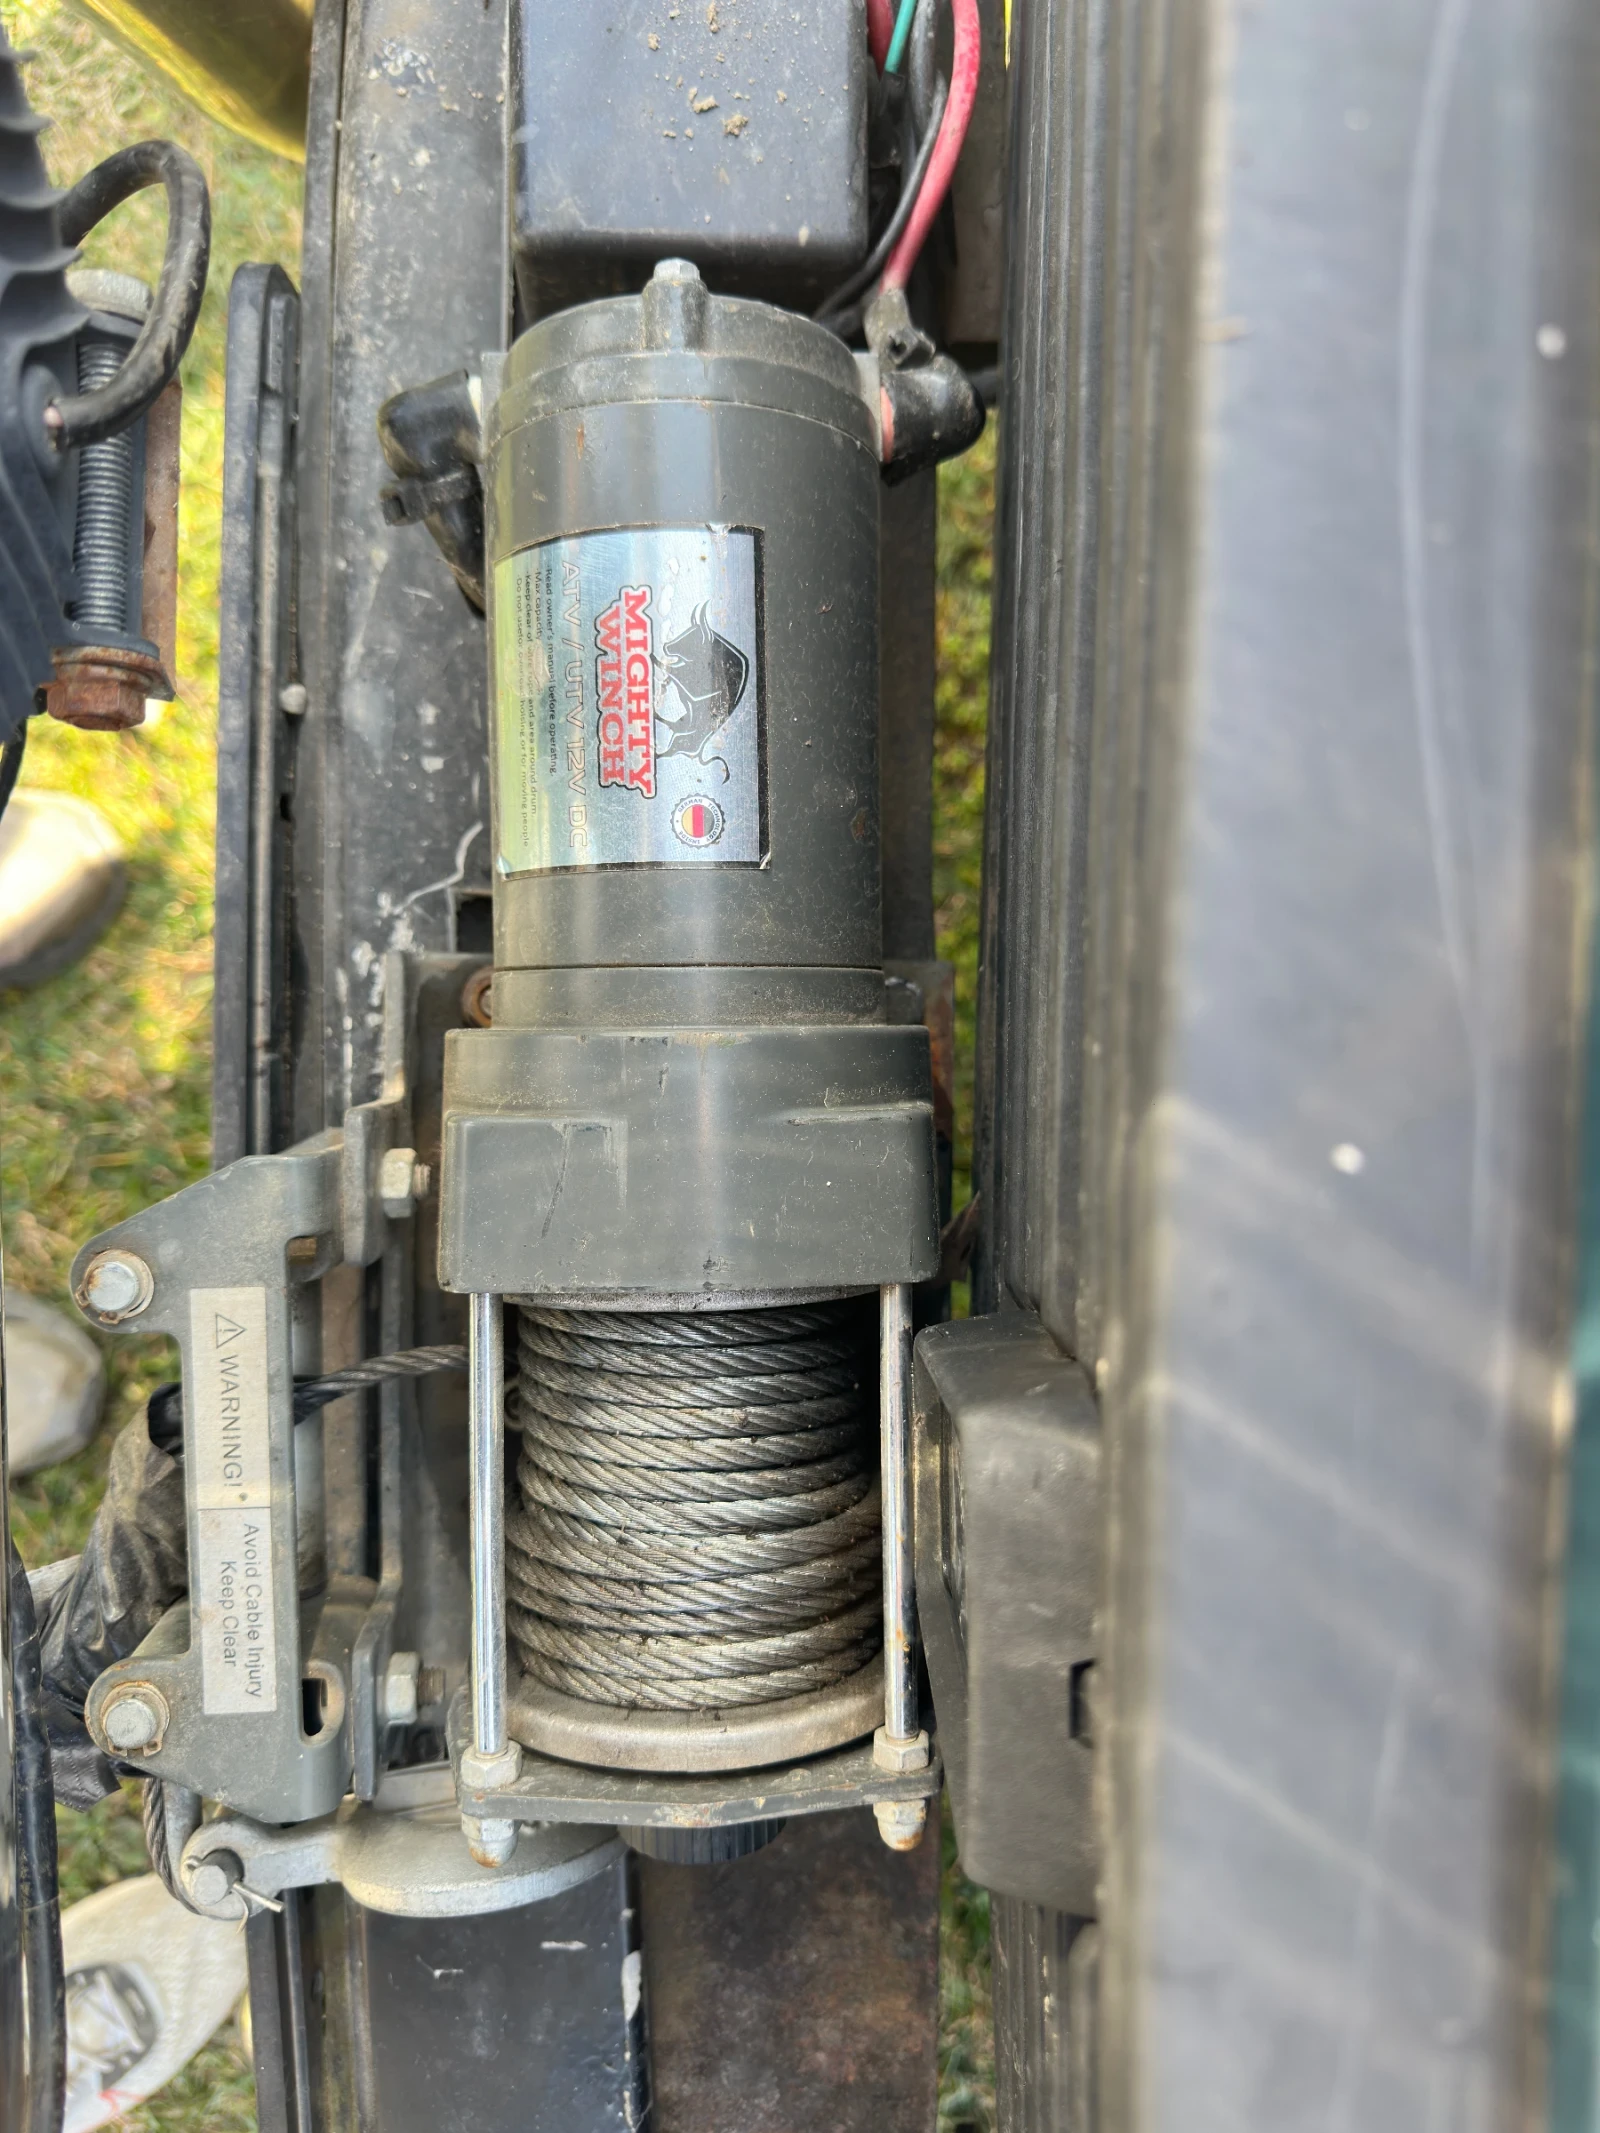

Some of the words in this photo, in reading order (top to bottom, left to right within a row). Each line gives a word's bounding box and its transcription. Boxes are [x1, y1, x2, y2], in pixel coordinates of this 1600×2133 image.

[534, 597, 543, 640] capacity
[546, 598, 554, 640] owner's
[562, 561, 582, 628] ATV
[526, 632, 533, 643] of
[547, 643, 556, 682] manual
[562, 638, 585, 650] /
[548, 685, 557, 720] before
[565, 660, 584, 729] UTV
[600, 606, 624, 784] WINCH
[625, 591, 652, 794] MIGHTY
[548, 723, 558, 776] operating.
[567, 737, 586, 795] 12V
[569, 805, 587, 847] DC
[679, 831, 700, 844] INSIDE
[706, 802, 721, 842] TECHNOLOGY
[220, 1354, 243, 1487] WARNING!
[244, 1523, 261, 1577] Avoid
[219, 1561, 237, 1609] Keep
[245, 1584, 263, 1641] Cable
[223, 1616, 239, 1667] Clear
[245, 1647, 264, 1698] Injury
